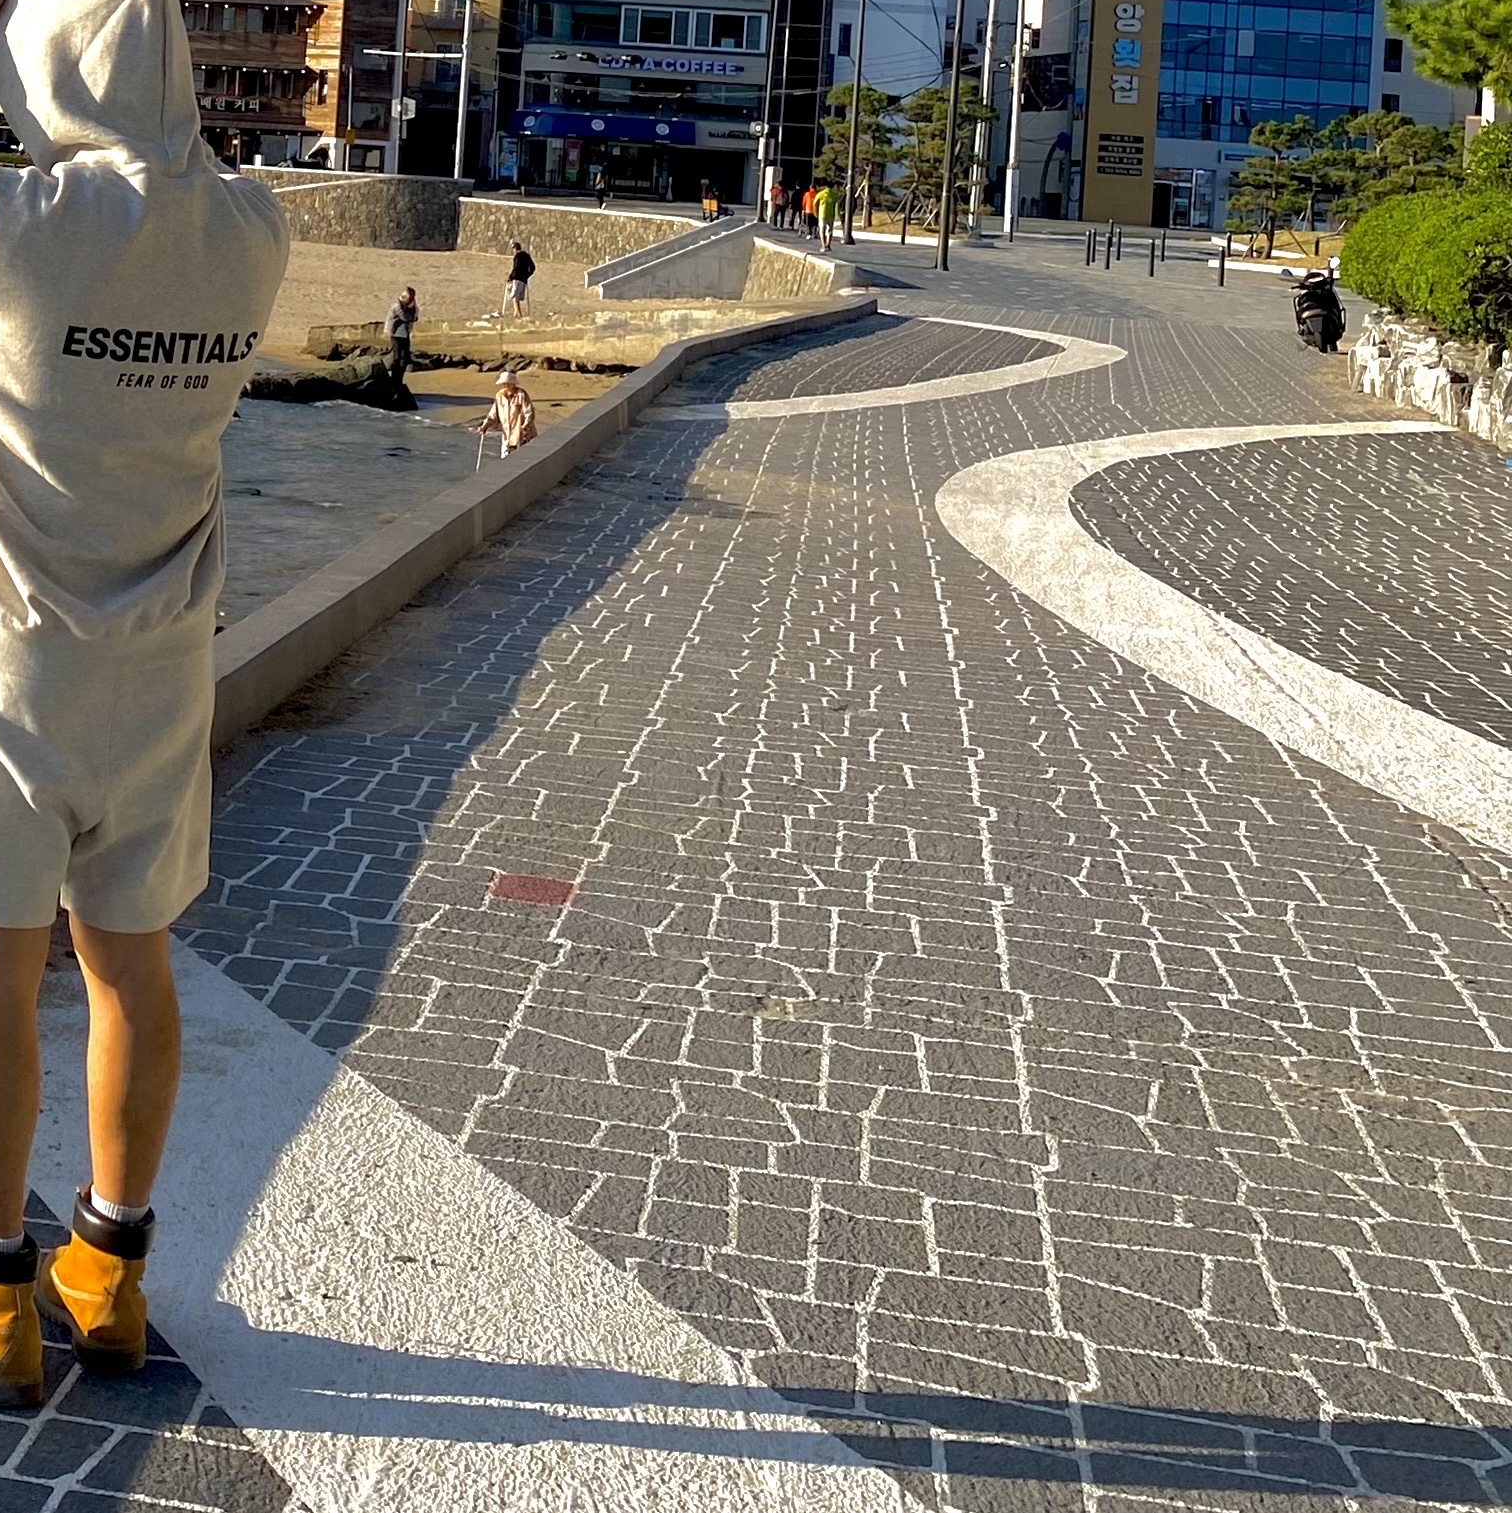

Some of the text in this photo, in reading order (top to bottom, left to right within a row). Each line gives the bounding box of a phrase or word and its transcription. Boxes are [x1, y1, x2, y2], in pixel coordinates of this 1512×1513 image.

[661, 57, 737, 76] COFFEE
[233, 97, 260, 113] 커피
[61, 325, 259, 364] ESSENTIALS
[116, 373, 155, 389] FEAR
[160, 374, 178, 389] OF
